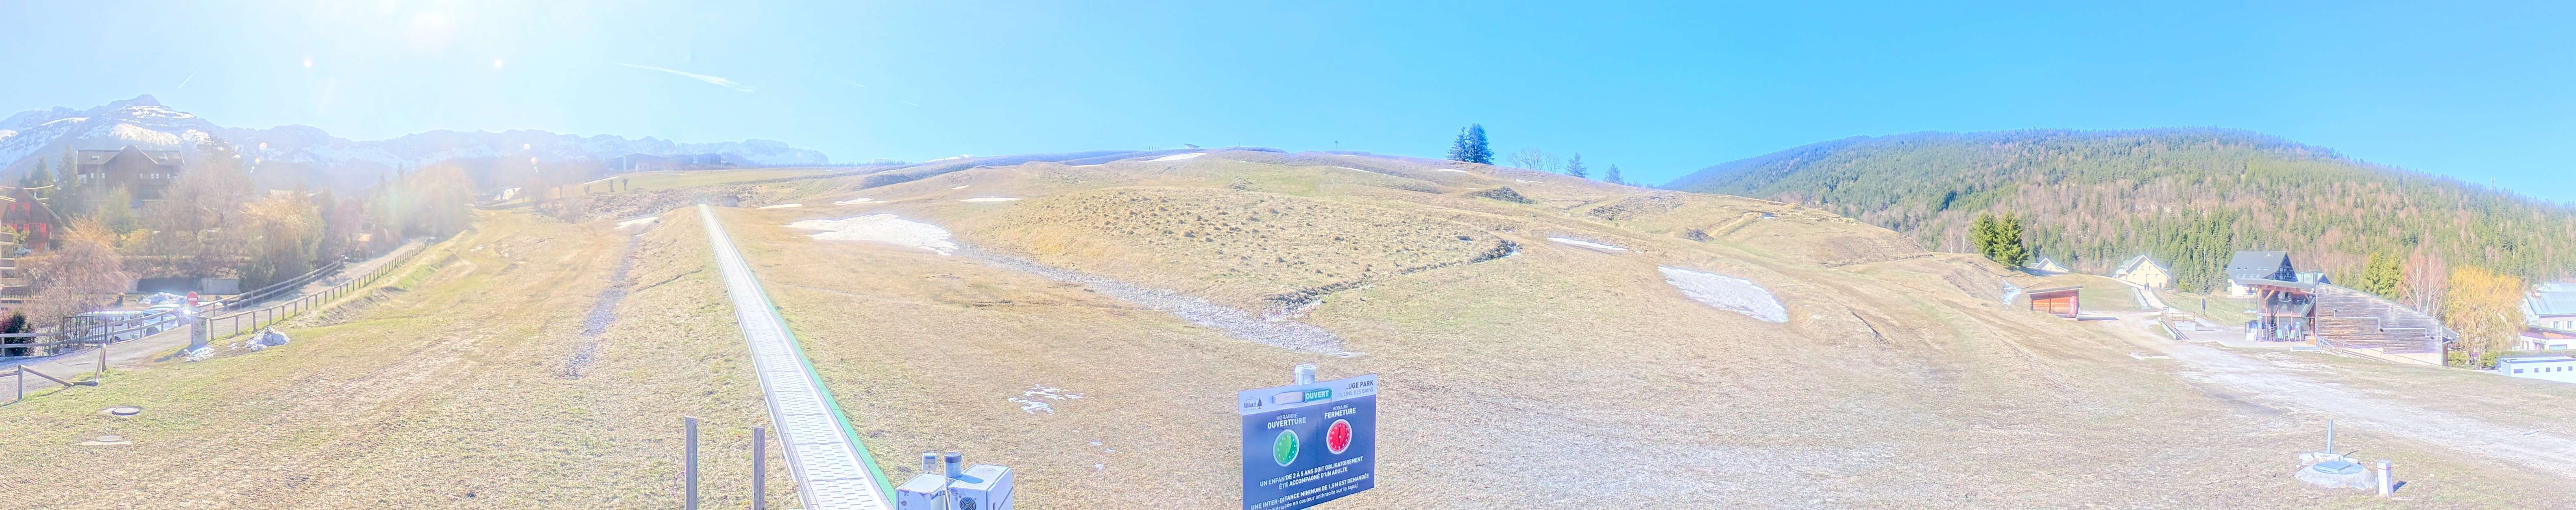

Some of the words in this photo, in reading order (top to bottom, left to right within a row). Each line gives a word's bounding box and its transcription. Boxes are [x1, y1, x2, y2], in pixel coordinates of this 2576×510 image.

[1306, 390, 1329, 399] OUVERT
[1325, 407, 1356, 419] FERMETURE
[1325, 456, 1363, 470] OBLIGATOIREMENT
[1289, 473, 1320, 486] ACCOMPAGNÉ
[1332, 467, 1348, 475] ADULTE
[1301, 487, 1321, 497] MINIMUM
[1347, 473, 1369, 484] DEMANDÉE
[1299, 496, 1315, 504] couleur
[1316, 490, 1336, 499] anthracite
